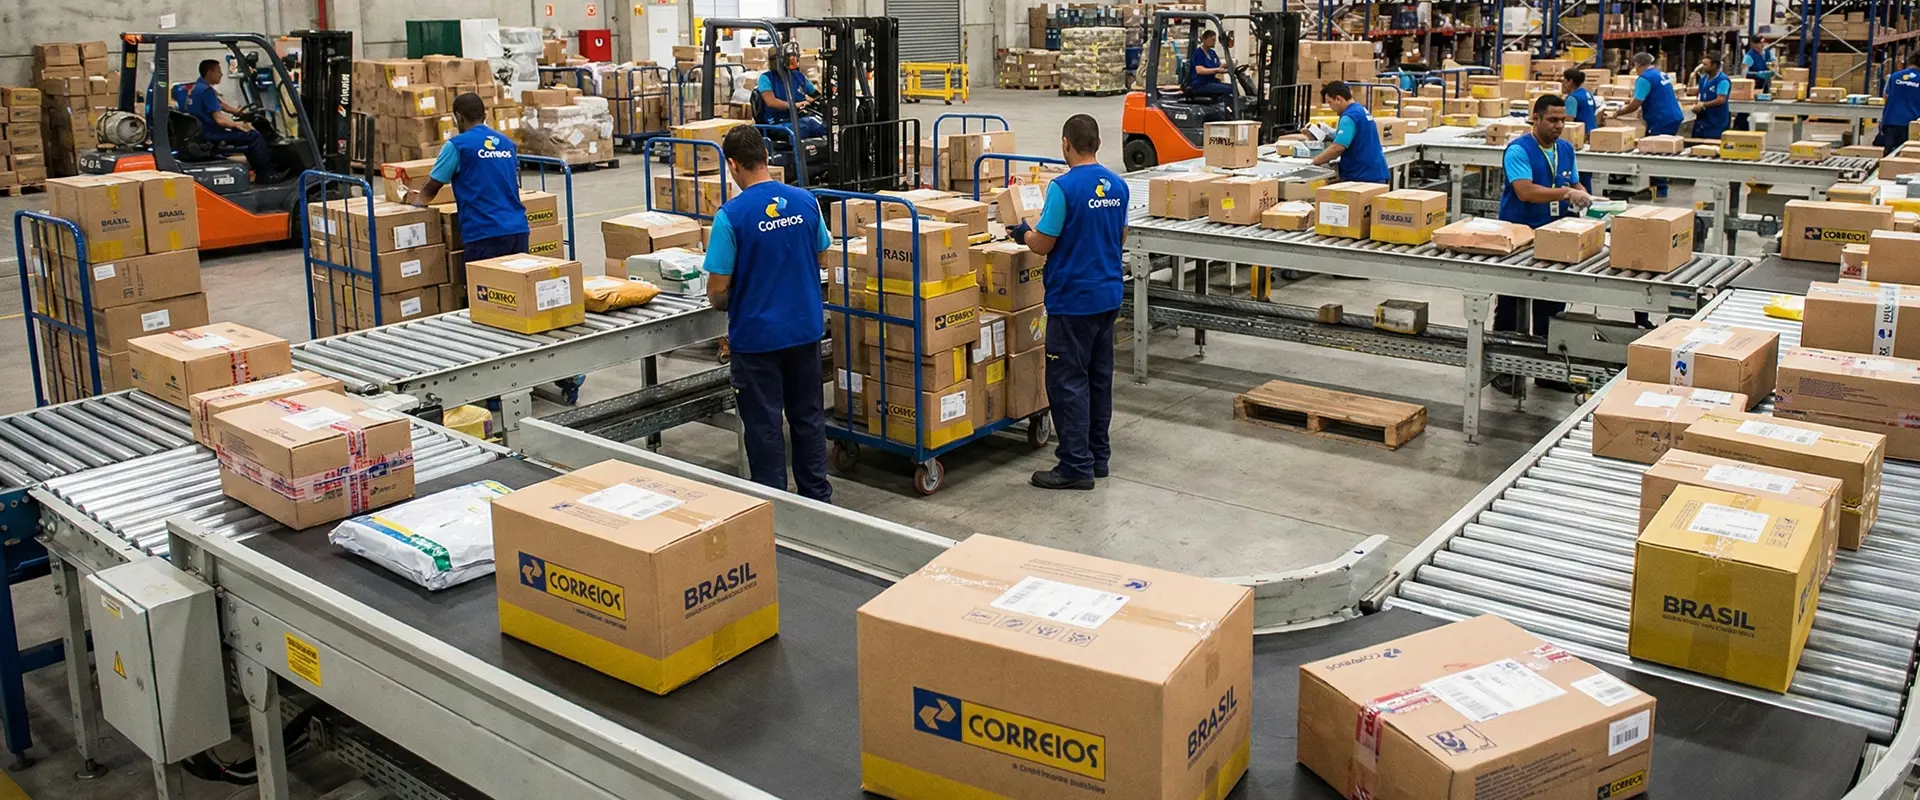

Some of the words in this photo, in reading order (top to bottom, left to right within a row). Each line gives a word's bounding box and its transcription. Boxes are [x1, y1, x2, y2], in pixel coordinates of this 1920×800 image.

[758, 214, 804, 232] Correios
[549, 571, 621, 612] CORREIOS
[684, 562, 757, 611] BRASIL
[1663, 595, 1756, 631] BRASIL
[968, 714, 1099, 768] CORREIOS
[1187, 685, 1238, 760] BRASIL
